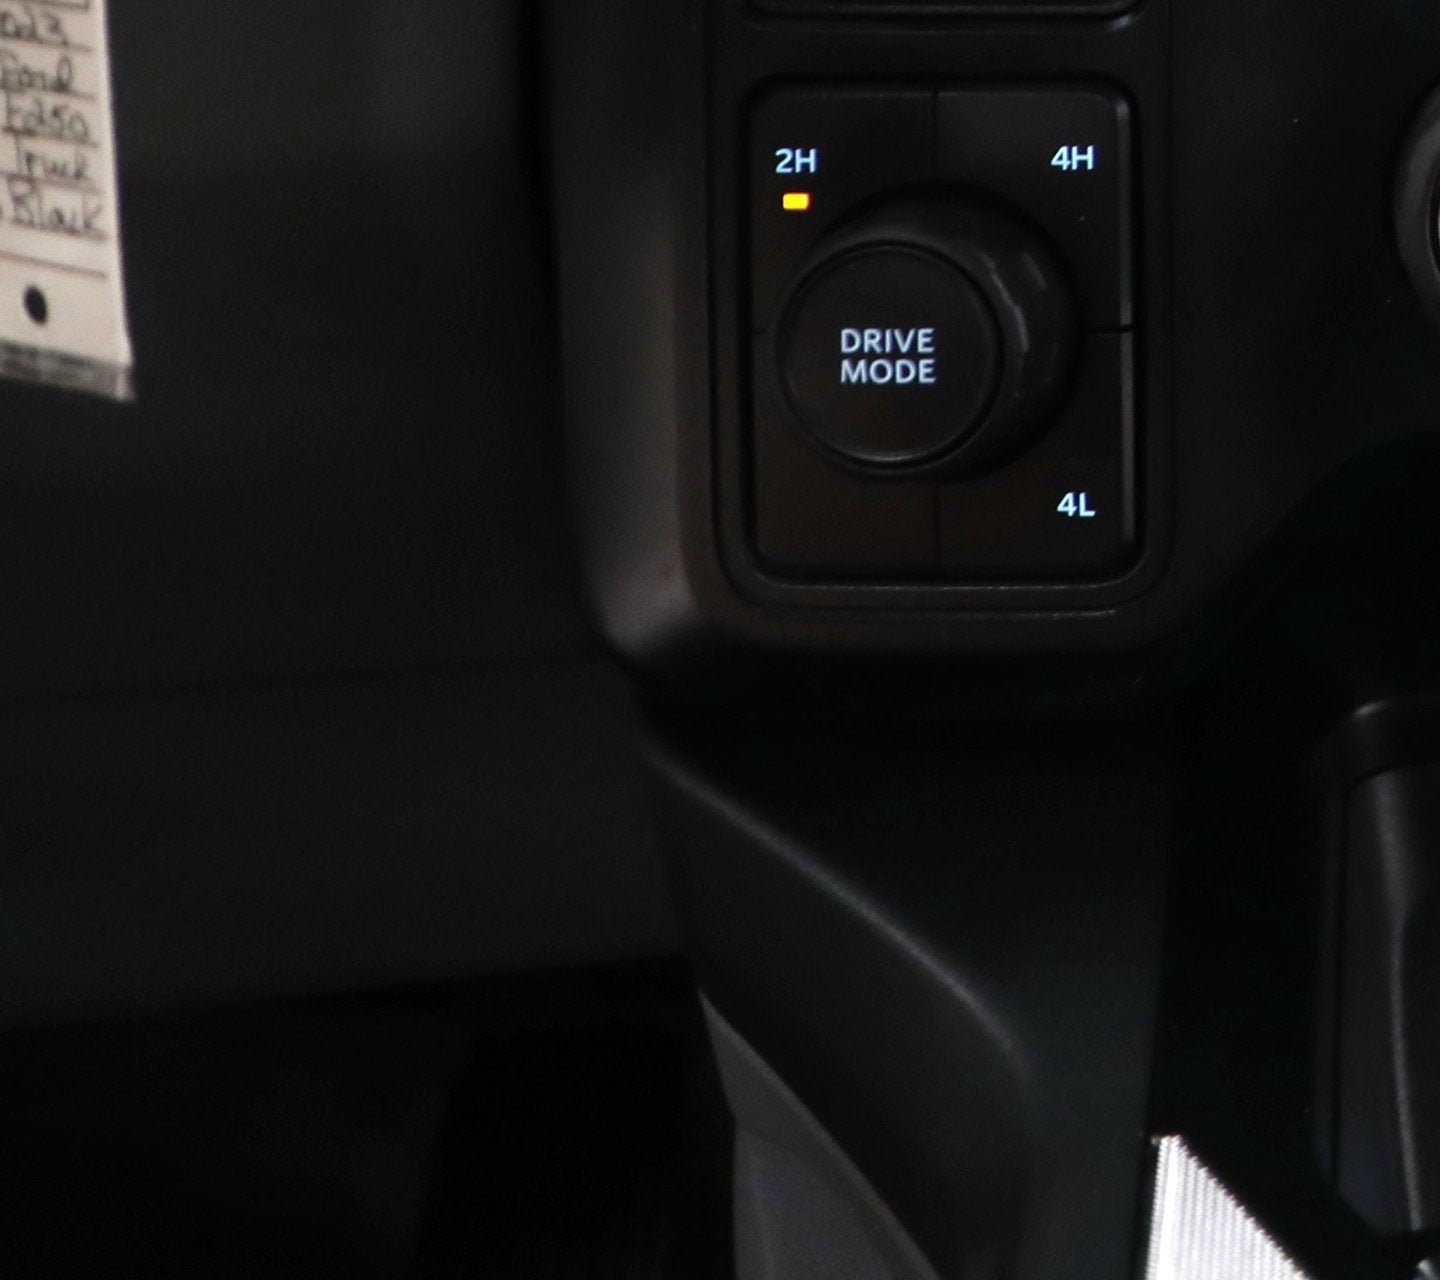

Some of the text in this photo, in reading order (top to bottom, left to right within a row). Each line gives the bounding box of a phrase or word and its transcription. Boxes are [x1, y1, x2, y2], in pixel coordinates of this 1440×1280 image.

[775, 148, 816, 173] 2H
[1050, 145, 1094, 171] 4H
[841, 328, 935, 354] DRIVE
[840, 358, 935, 384] MODE
[1057, 492, 1096, 517] 4L
